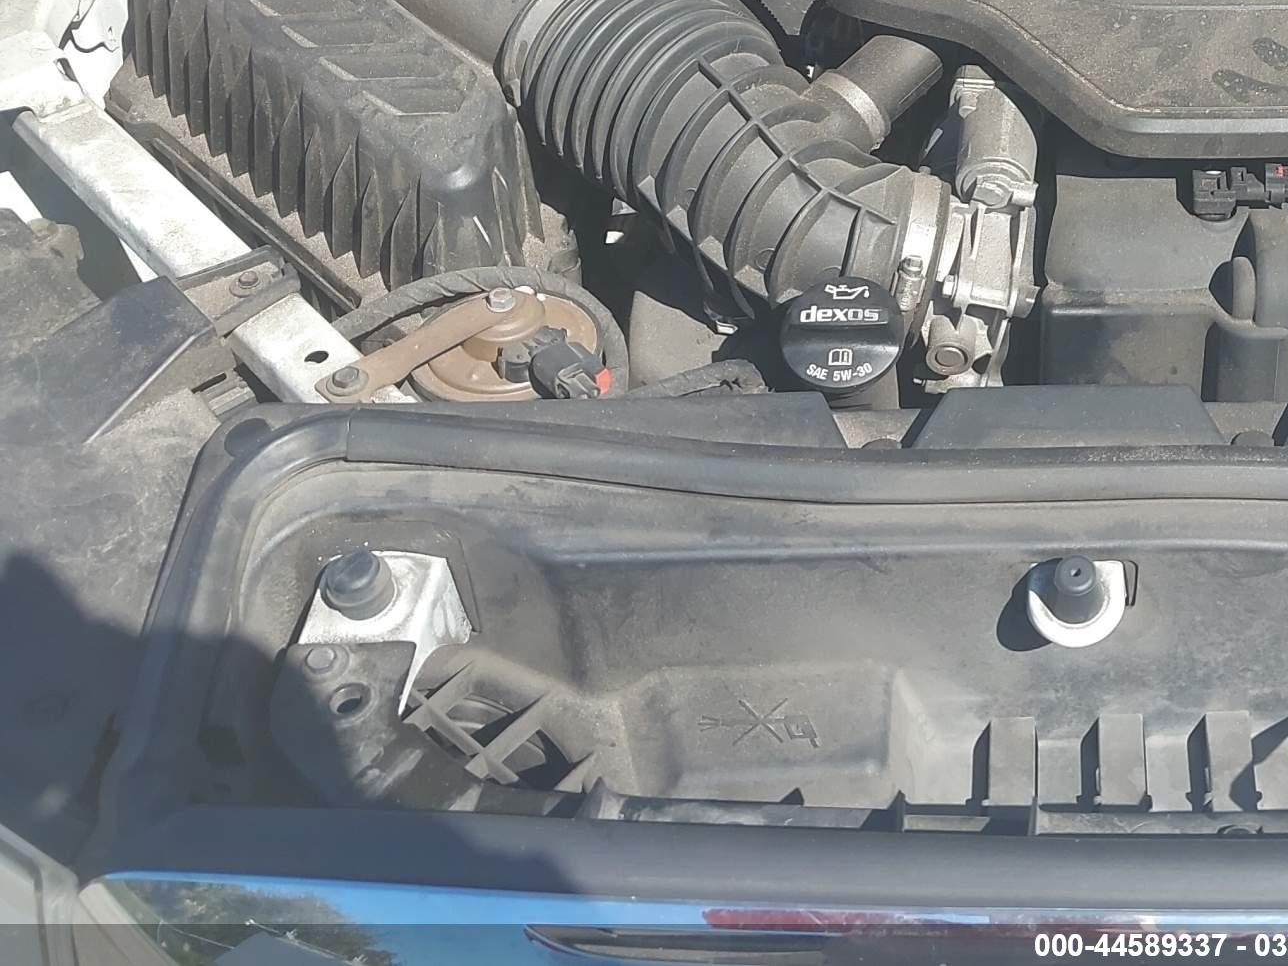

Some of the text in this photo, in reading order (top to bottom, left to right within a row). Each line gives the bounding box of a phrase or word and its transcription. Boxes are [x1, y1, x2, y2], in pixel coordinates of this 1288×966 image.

[800, 305, 882, 323] dexos
[806, 362, 873, 382] SAE 5W-30
